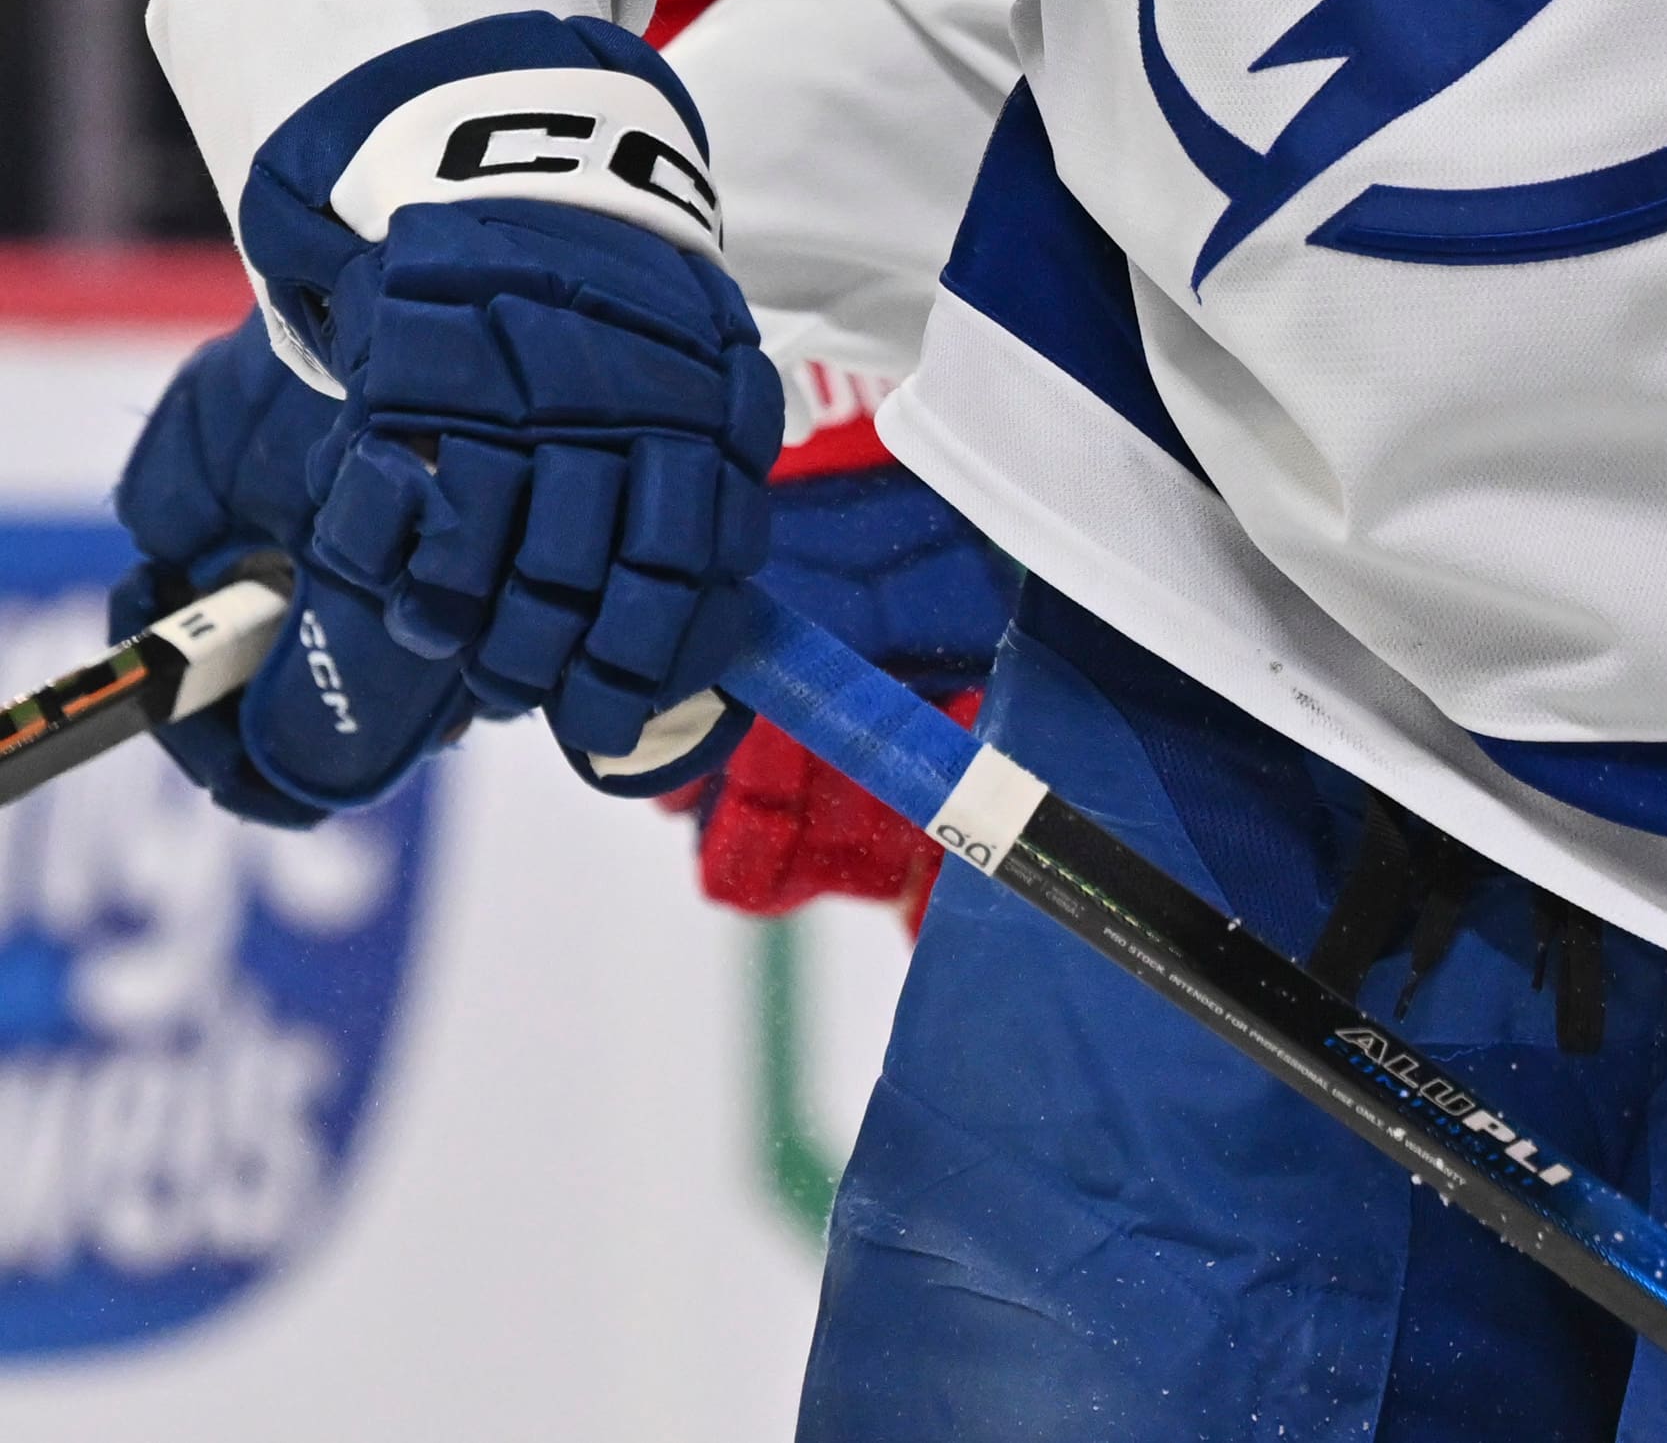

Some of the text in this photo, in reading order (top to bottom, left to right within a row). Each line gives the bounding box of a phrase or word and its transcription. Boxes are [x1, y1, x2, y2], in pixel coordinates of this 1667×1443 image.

[435, 111, 723, 251] CC
[300, 609, 358, 734] CCM
[1102, 926, 1128, 948] PRO
[1168, 974, 1225, 1015] INTENDED
[1223, 1011, 1250, 1033] FOR
[1249, 1030, 1329, 1090] PROFESSIONAL
[1328, 1086, 1355, 1108] USE
